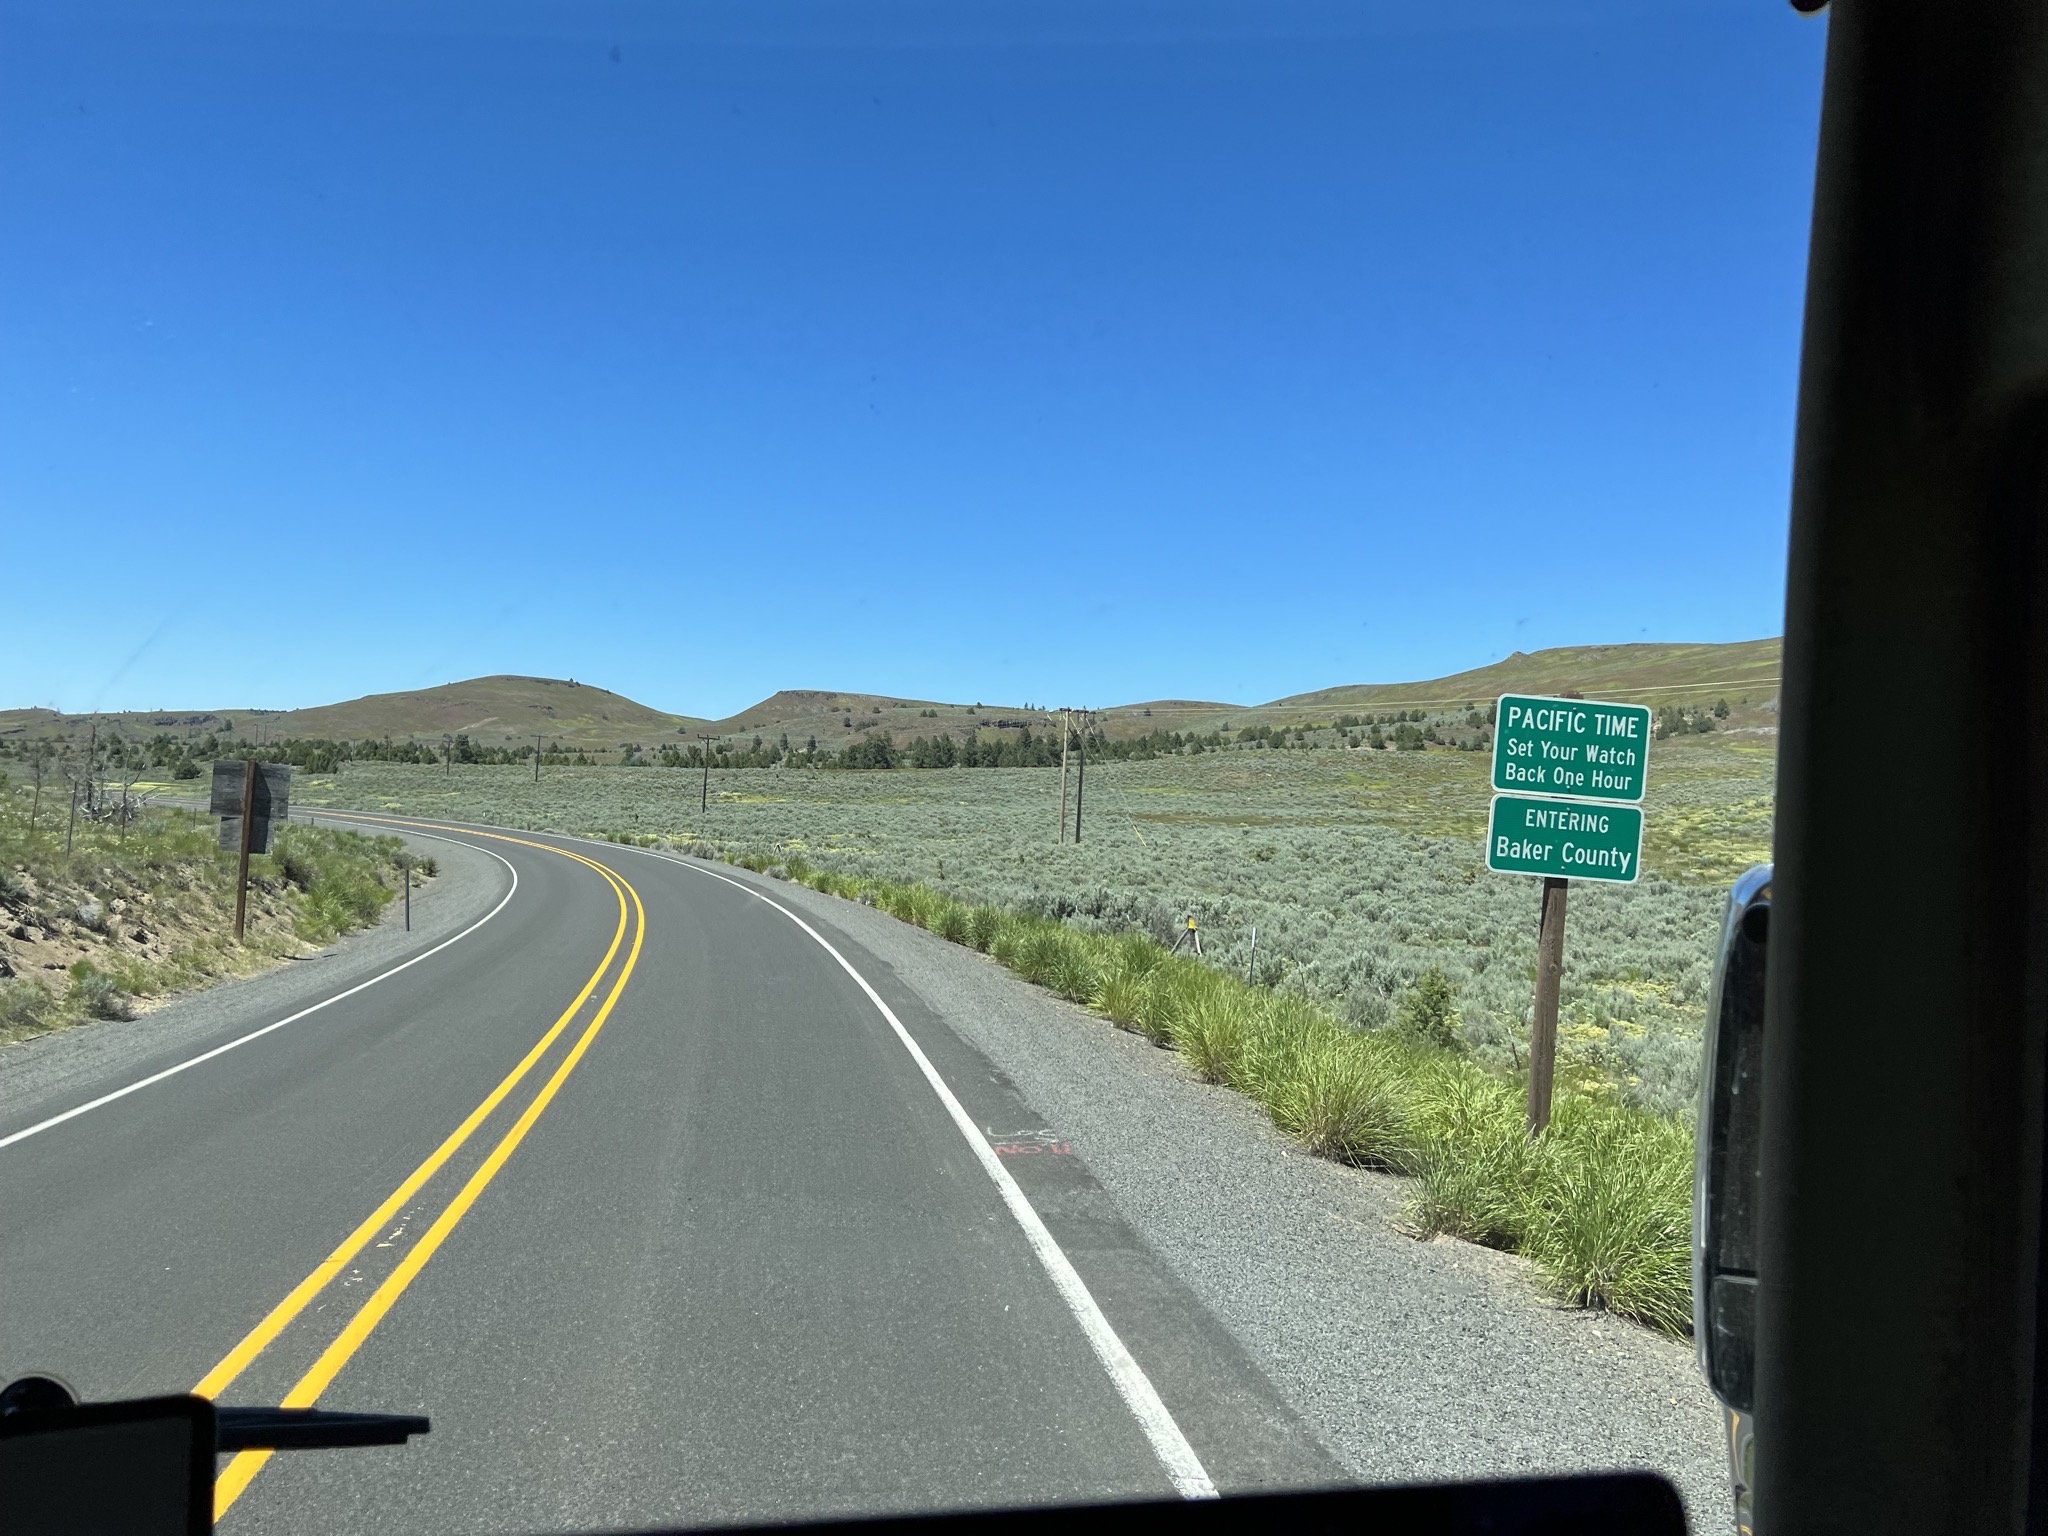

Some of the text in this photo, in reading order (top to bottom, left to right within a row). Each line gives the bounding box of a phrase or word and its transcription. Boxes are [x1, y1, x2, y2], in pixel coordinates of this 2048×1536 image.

[1508, 706, 1639, 738] PACIFIC TIME
[1507, 738, 1636, 766] Set Your Watch
[1505, 762, 1632, 790] Back One Hour
[1525, 808, 1609, 834] ENTERING
[1496, 836, 1632, 874] Baker County
